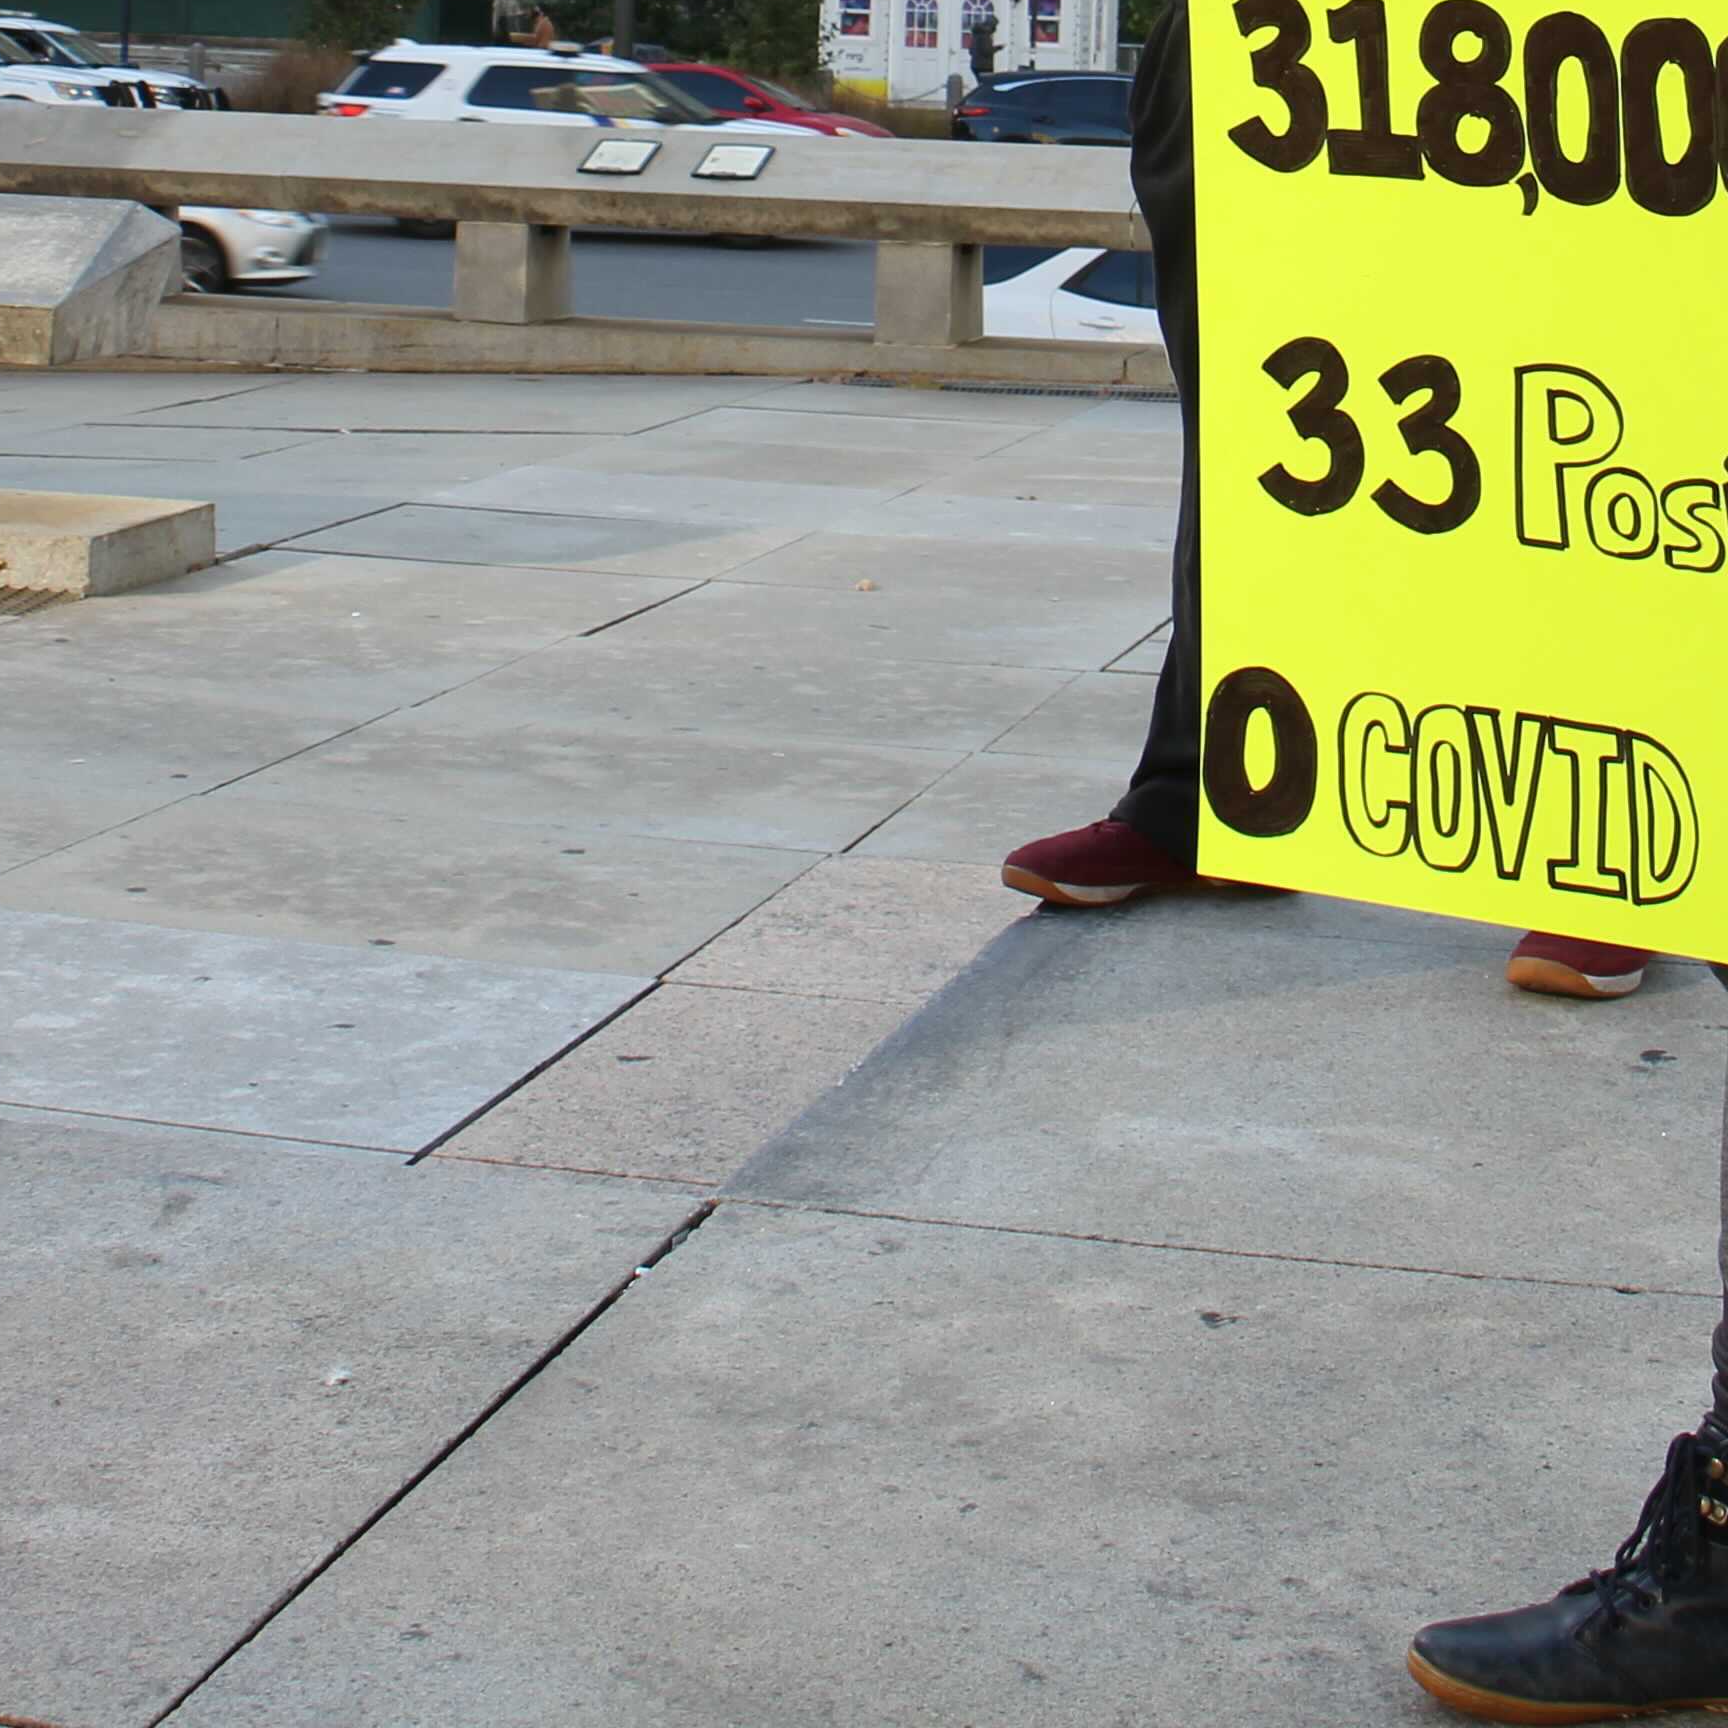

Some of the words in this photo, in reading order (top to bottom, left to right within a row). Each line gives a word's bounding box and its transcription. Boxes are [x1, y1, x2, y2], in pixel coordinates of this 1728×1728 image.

[1257, 337, 1483, 534] 33
[1201, 666, 1318, 840] 0
[1337, 690, 1702, 909] COVID
